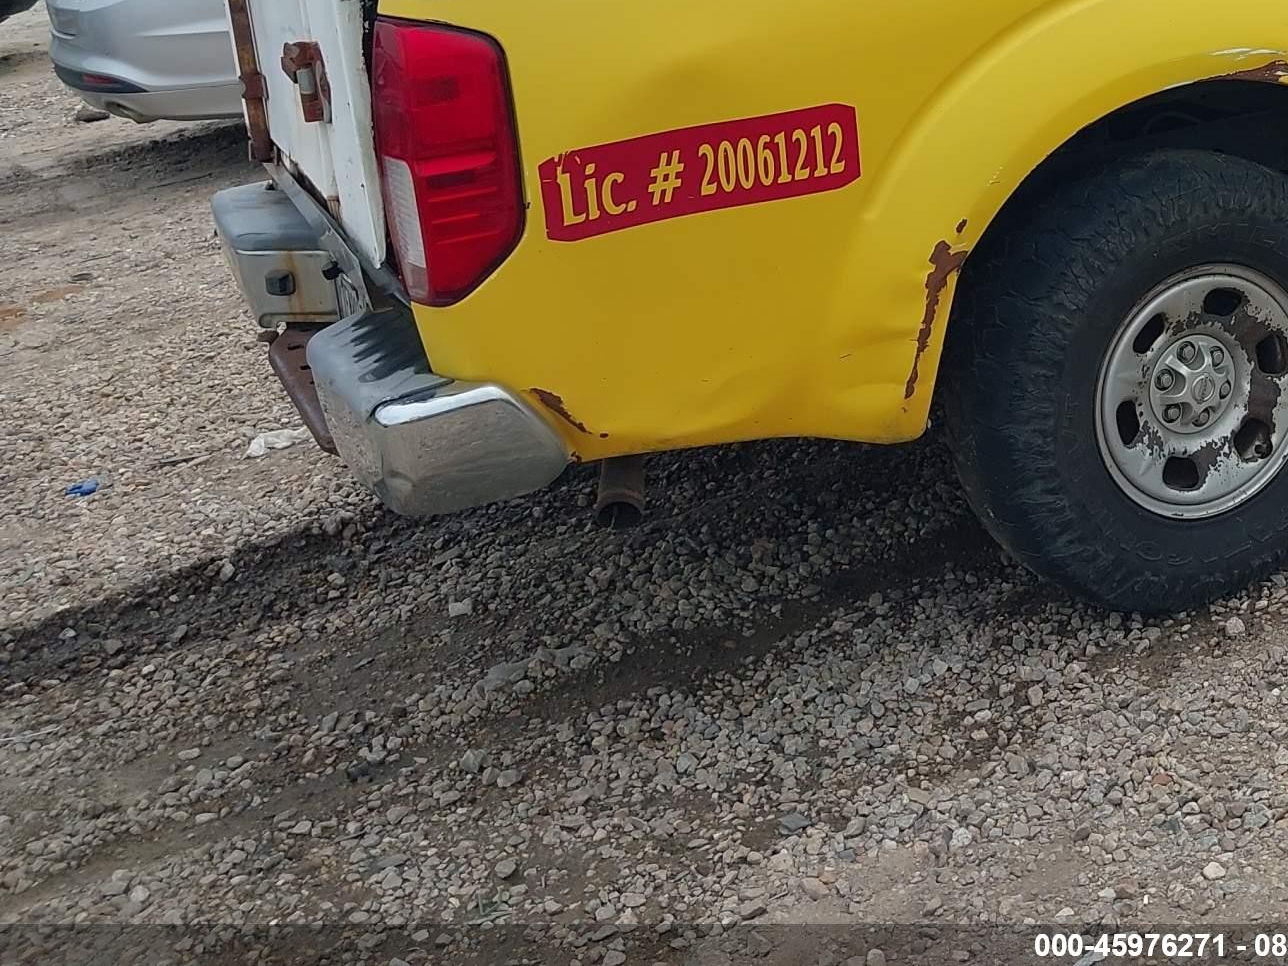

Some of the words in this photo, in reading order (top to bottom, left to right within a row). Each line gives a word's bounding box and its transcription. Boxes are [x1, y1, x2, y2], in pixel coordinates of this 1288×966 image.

[556, 162, 637, 226] Lic.
[647, 149, 685, 206] #
[698, 122, 846, 197] 20061212
